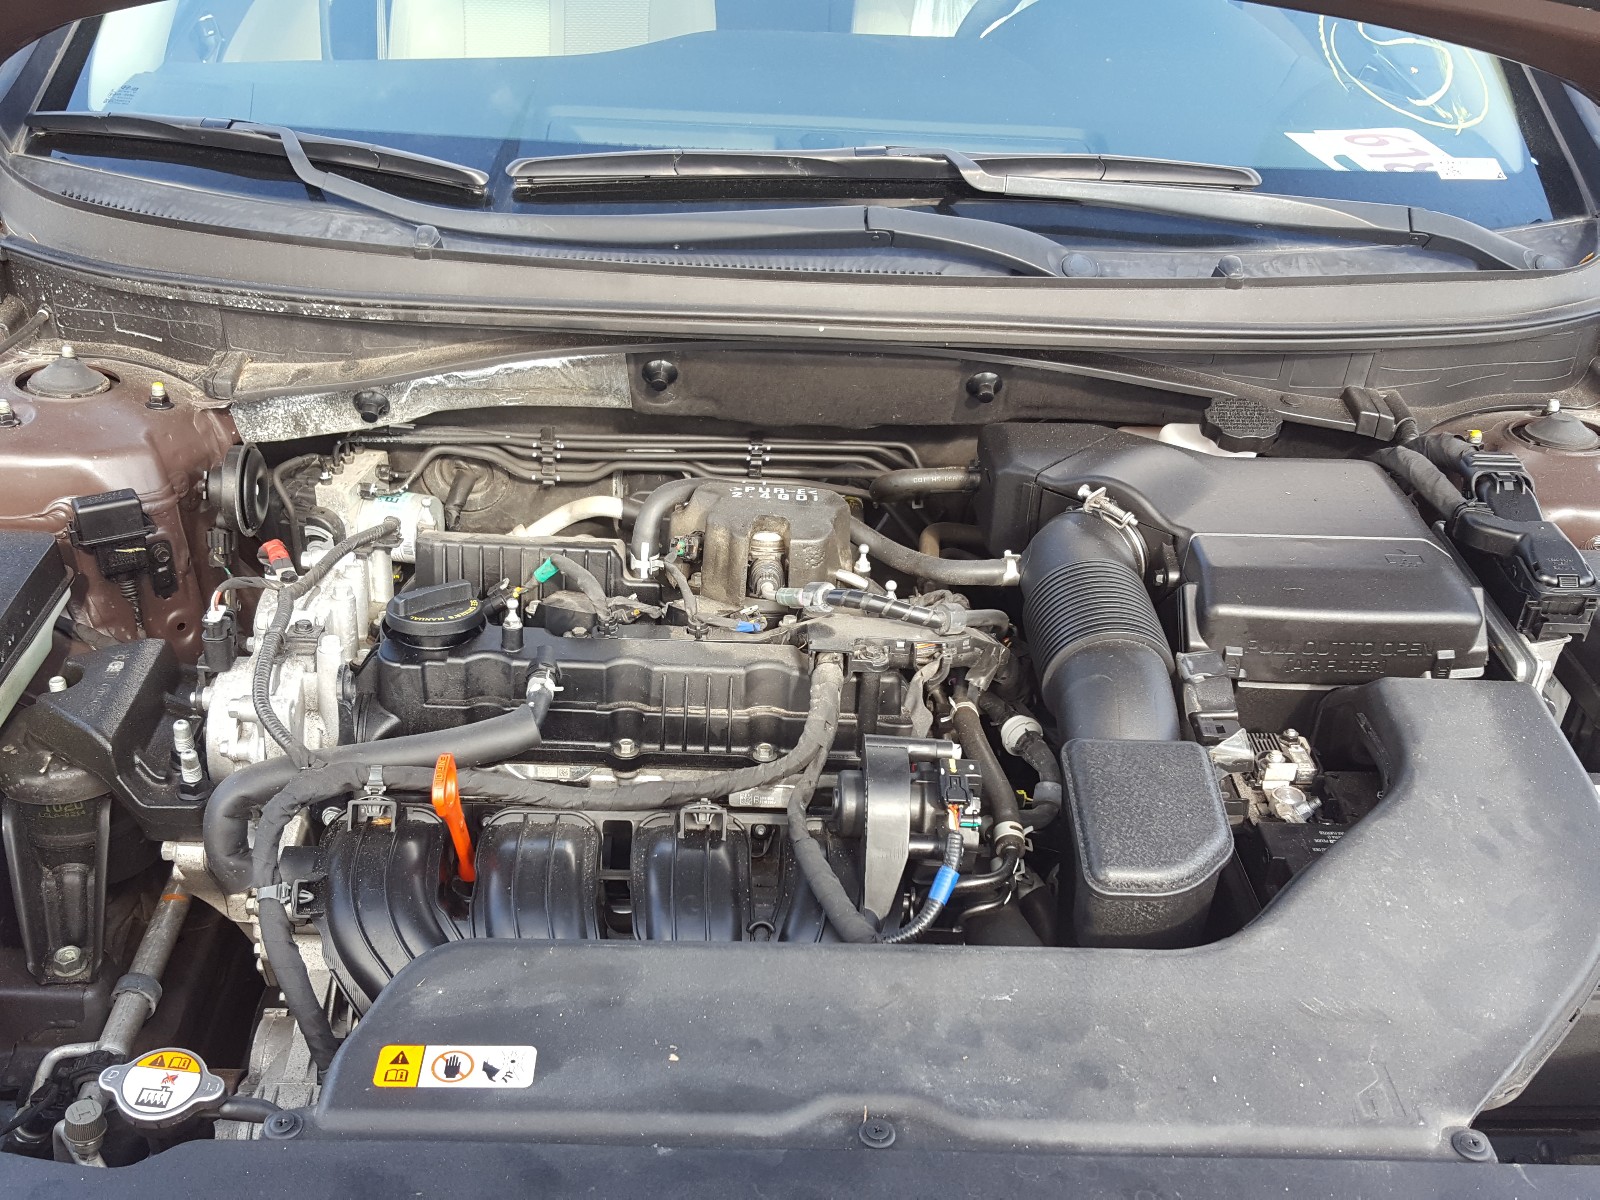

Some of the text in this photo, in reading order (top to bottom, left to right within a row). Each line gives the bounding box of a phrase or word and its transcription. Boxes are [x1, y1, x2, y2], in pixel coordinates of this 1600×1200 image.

[1245, 640, 1296, 656] PULL
[1350, 642, 1374, 657] TO
[1380, 642, 1437, 657] OPEN
